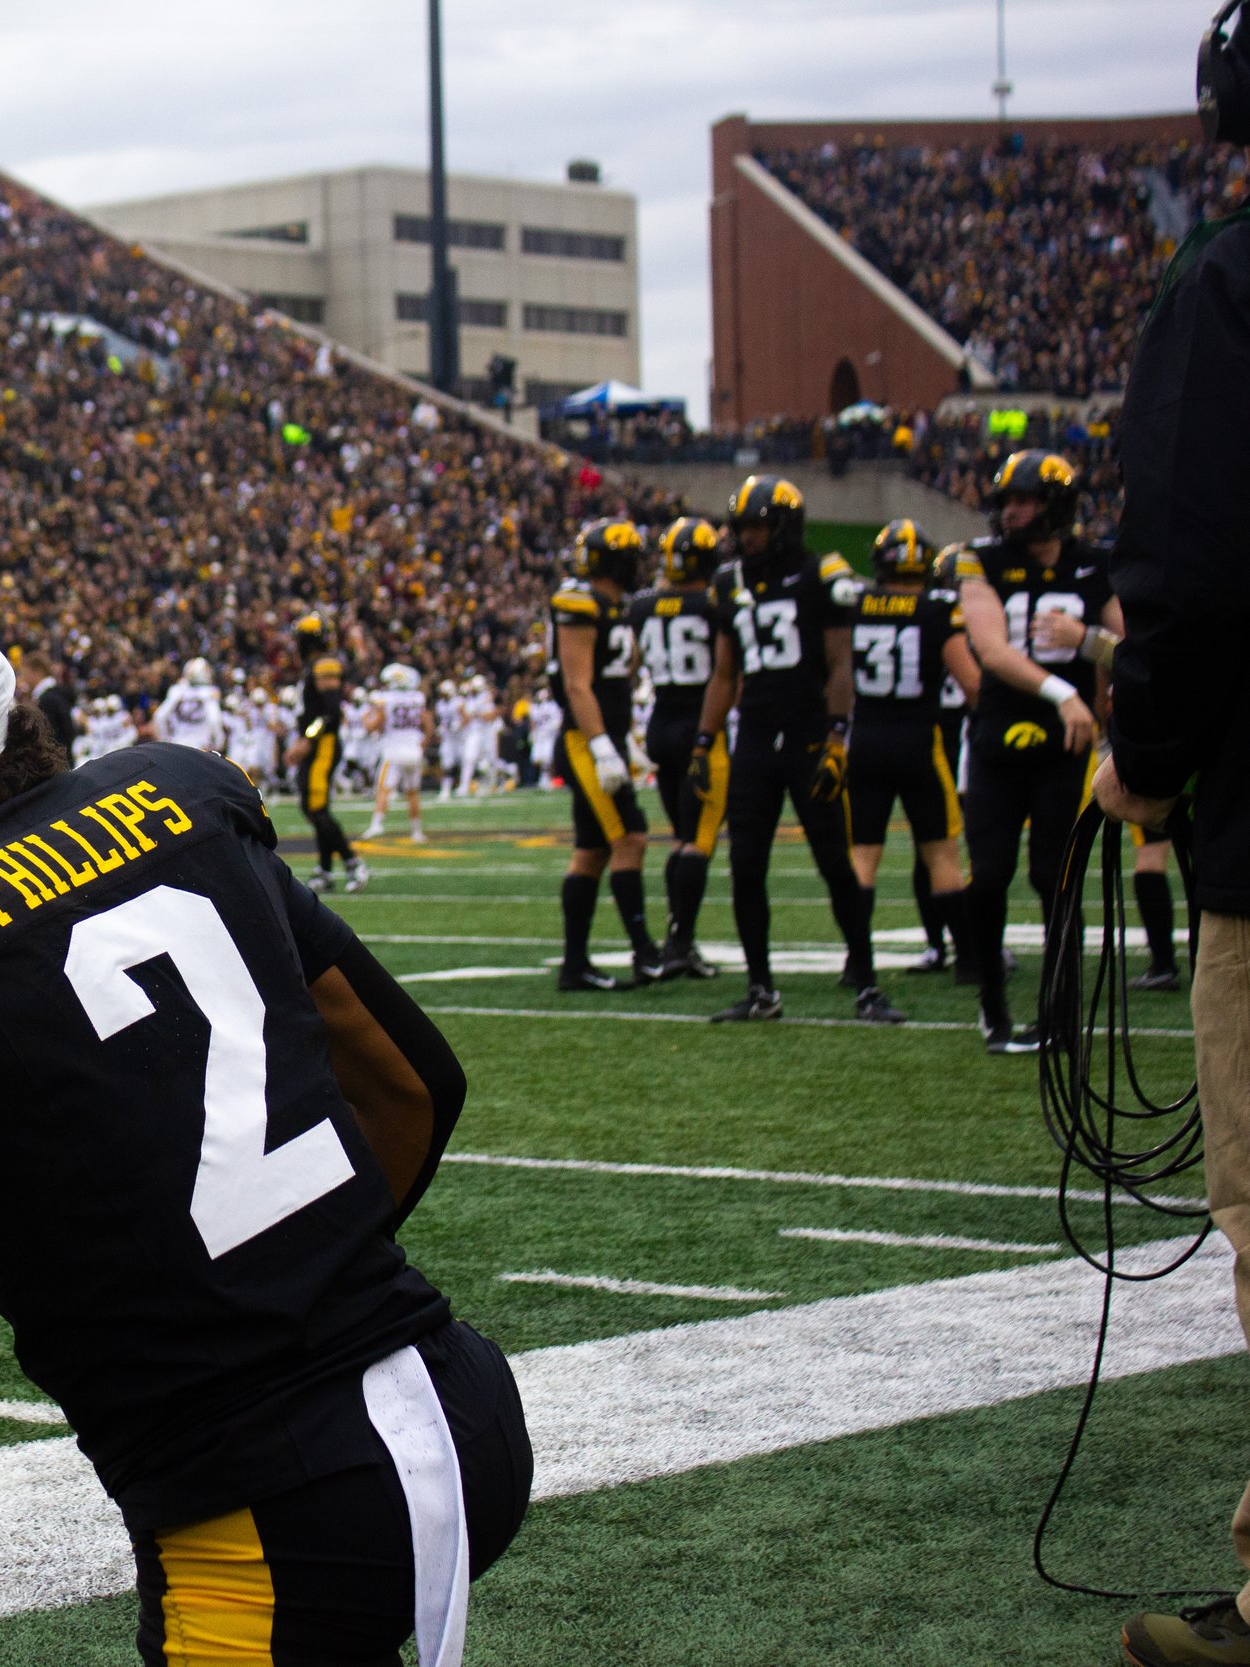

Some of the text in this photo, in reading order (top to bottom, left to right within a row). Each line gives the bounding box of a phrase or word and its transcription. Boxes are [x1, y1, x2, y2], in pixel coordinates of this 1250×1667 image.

[639, 615, 711, 686] 46
[734, 599, 801, 675] 13
[853, 624, 923, 699] 31
[64, 884, 356, 1261] 2
